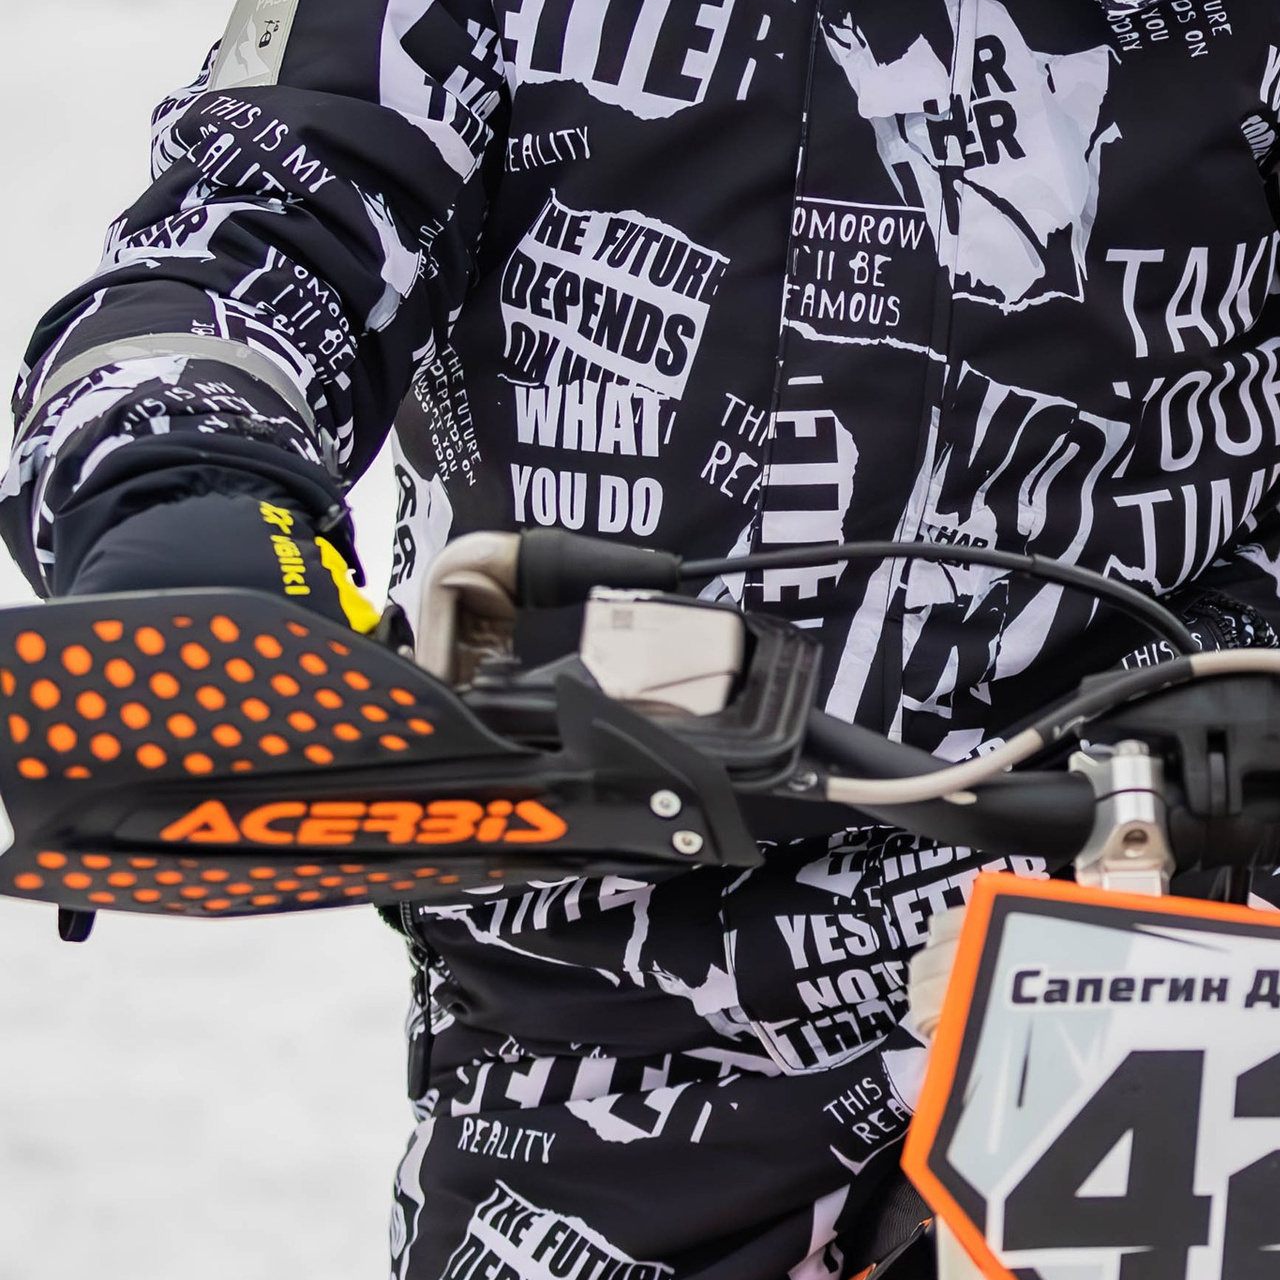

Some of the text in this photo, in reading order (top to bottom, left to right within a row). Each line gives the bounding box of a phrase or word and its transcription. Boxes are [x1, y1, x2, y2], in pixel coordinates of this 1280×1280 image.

[1141, 7, 1170, 41] YOU
[1185, 30, 1209, 58] ON
[201, 94, 337, 194] THIS IS MY
[848, 250, 893, 287] BE
[501, 246, 697, 378] DEPENDS
[430, 358, 477, 487] DEPENDS ON
[454, 388, 482, 465] FUTURE
[514, 379, 671, 458] WHAT
[510, 463, 664, 537] YOU DO
[160, 799, 568, 846] ACERBIS
[1010, 969, 1229, 1006] Сапегин
[822, 1077, 883, 1125] THIS
[457, 1117, 556, 1164] REALITY
